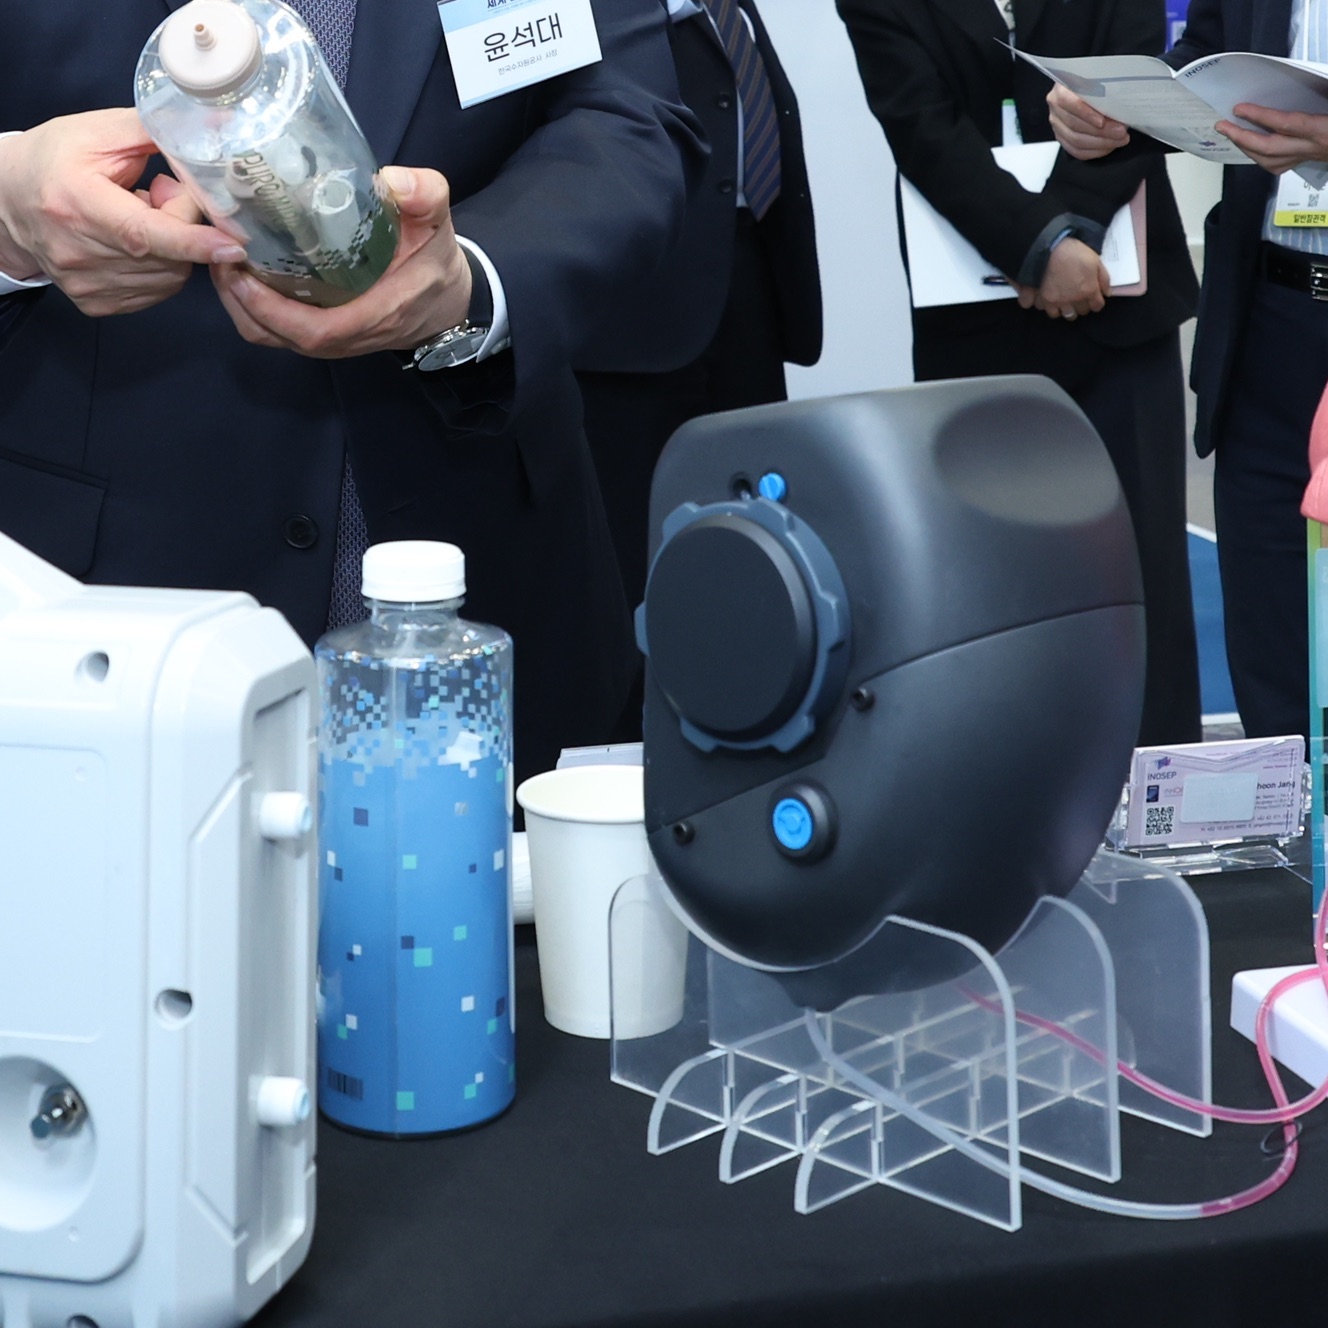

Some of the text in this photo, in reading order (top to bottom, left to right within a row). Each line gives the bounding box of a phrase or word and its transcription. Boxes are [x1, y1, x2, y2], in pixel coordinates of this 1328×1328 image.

[483, 12, 563, 63] 윤석대
[497, 55, 543, 76] 한국수자원공사
[1147, 771, 1178, 781] INOSEP
